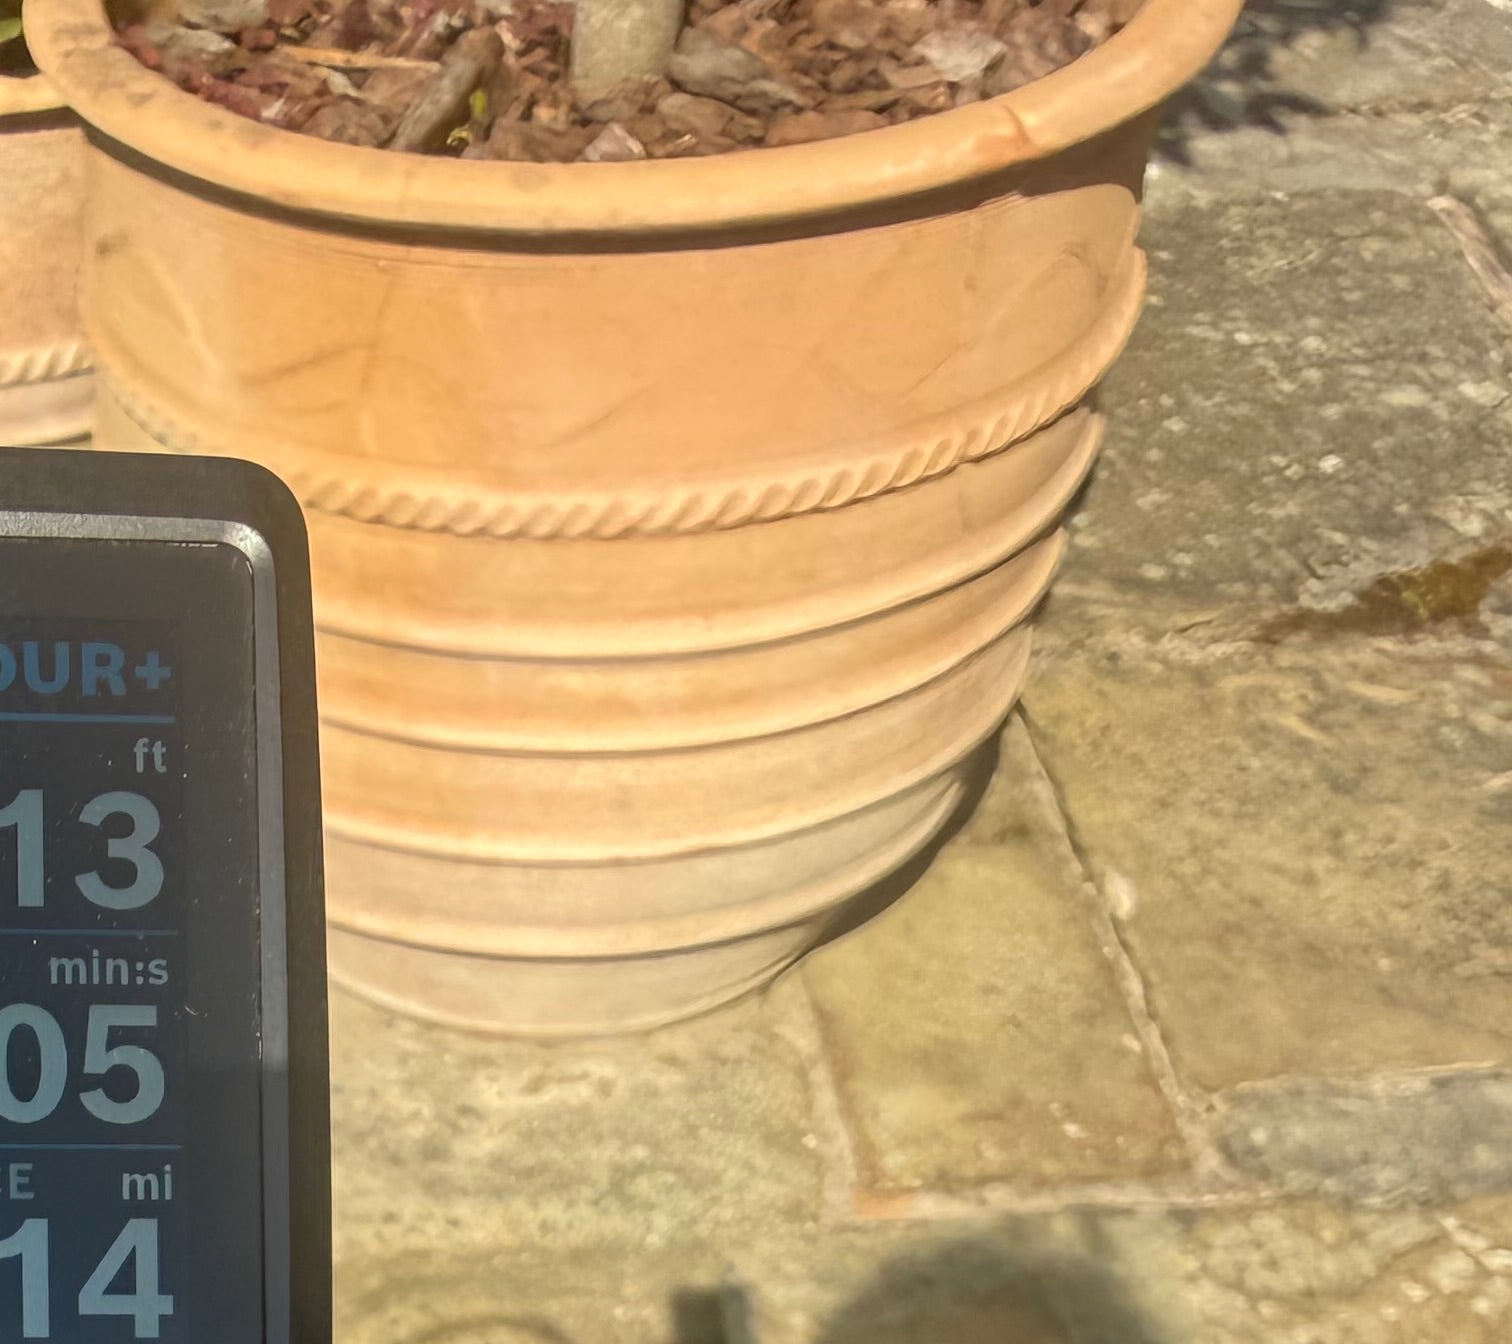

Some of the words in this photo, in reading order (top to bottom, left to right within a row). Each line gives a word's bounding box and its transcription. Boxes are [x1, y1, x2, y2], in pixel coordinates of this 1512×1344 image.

[133, 737, 168, 774] ft
[49, 949, 169, 986] min:s
[121, 1164, 173, 1201] mi
